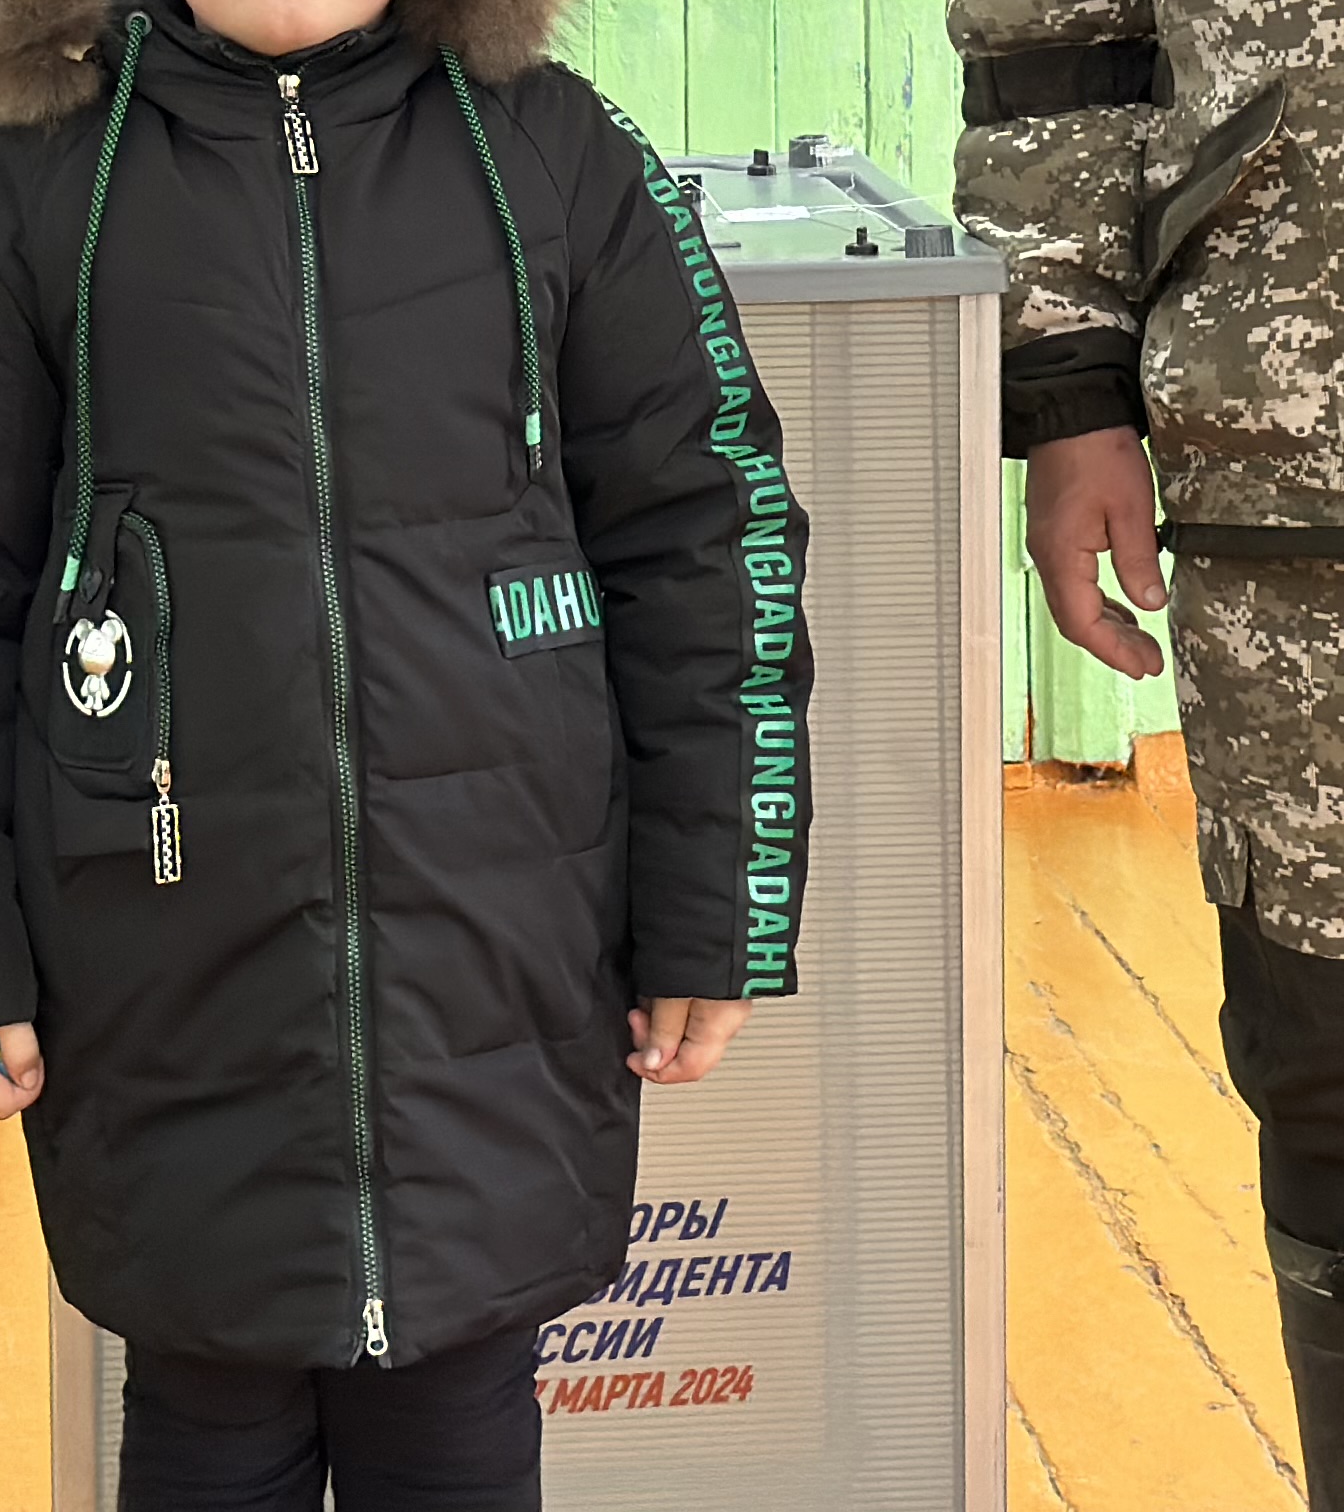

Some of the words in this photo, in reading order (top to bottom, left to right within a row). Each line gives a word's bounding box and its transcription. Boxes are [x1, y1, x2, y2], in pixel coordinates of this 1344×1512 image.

[584, 1251, 792, 1308] ИДЕНТА
[547, 1371, 666, 1416] МАРТА
[670, 1364, 755, 1408] 2024
